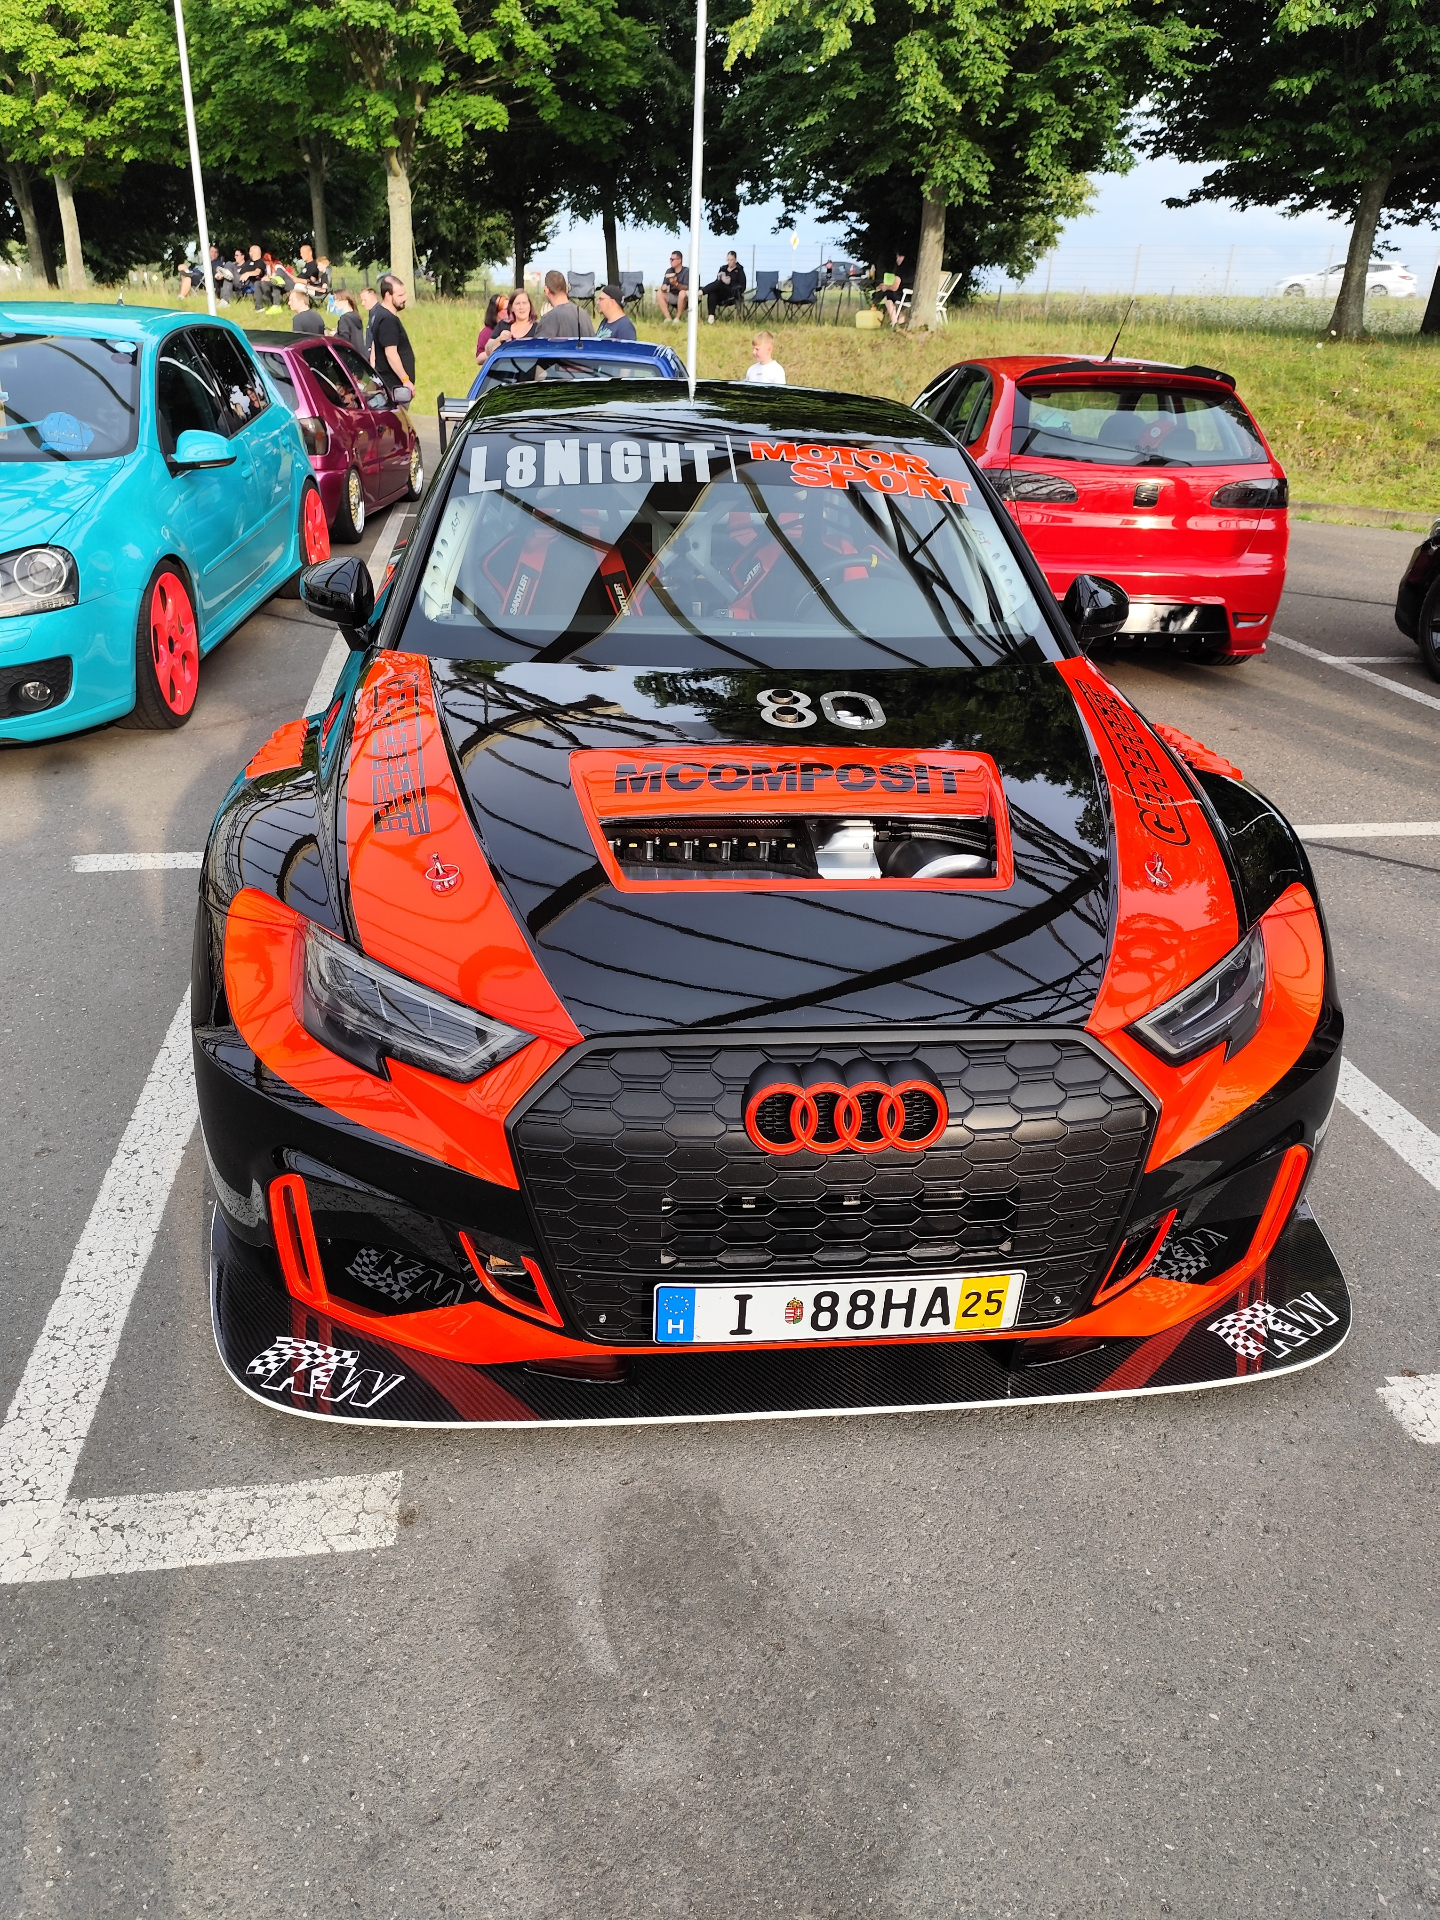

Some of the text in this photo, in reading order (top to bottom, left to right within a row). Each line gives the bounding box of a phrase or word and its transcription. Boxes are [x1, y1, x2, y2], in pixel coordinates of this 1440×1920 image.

[468, 439, 716, 494] L8NIGHT
[748, 440, 931, 477] MOTOR
[790, 462, 972, 506] SPORT
[509, 573, 529, 616] SANDTLER
[756, 688, 887, 731] 80
[613, 761, 967, 795] MCOMPOSIT
[667, 1318, 685, 1335] H
[810, 1285, 951, 1332] 88HA
[961, 1288, 1004, 1318] 25
